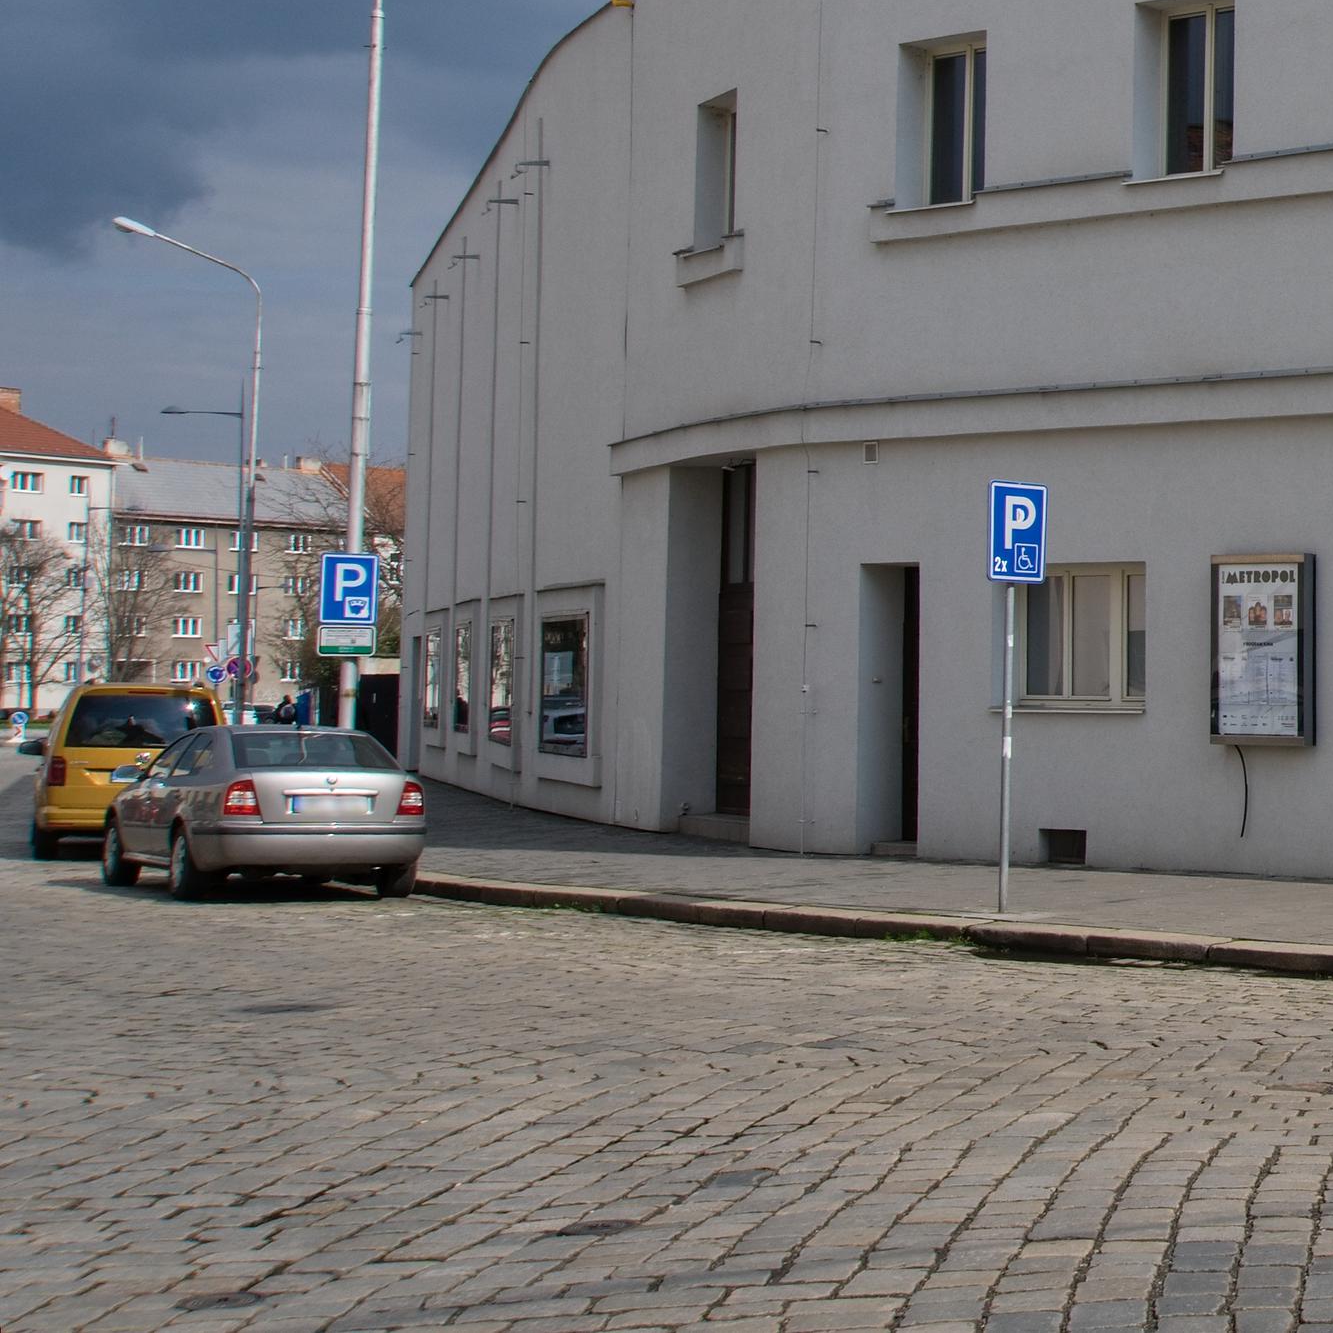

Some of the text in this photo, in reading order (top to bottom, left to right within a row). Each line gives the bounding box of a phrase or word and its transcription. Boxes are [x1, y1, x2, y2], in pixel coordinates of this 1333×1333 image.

[1003, 495, 1037, 550] P
[994, 556, 1009, 572] 2x
[1225, 570, 1296, 585] METROPOL
[333, 562, 368, 602] P
